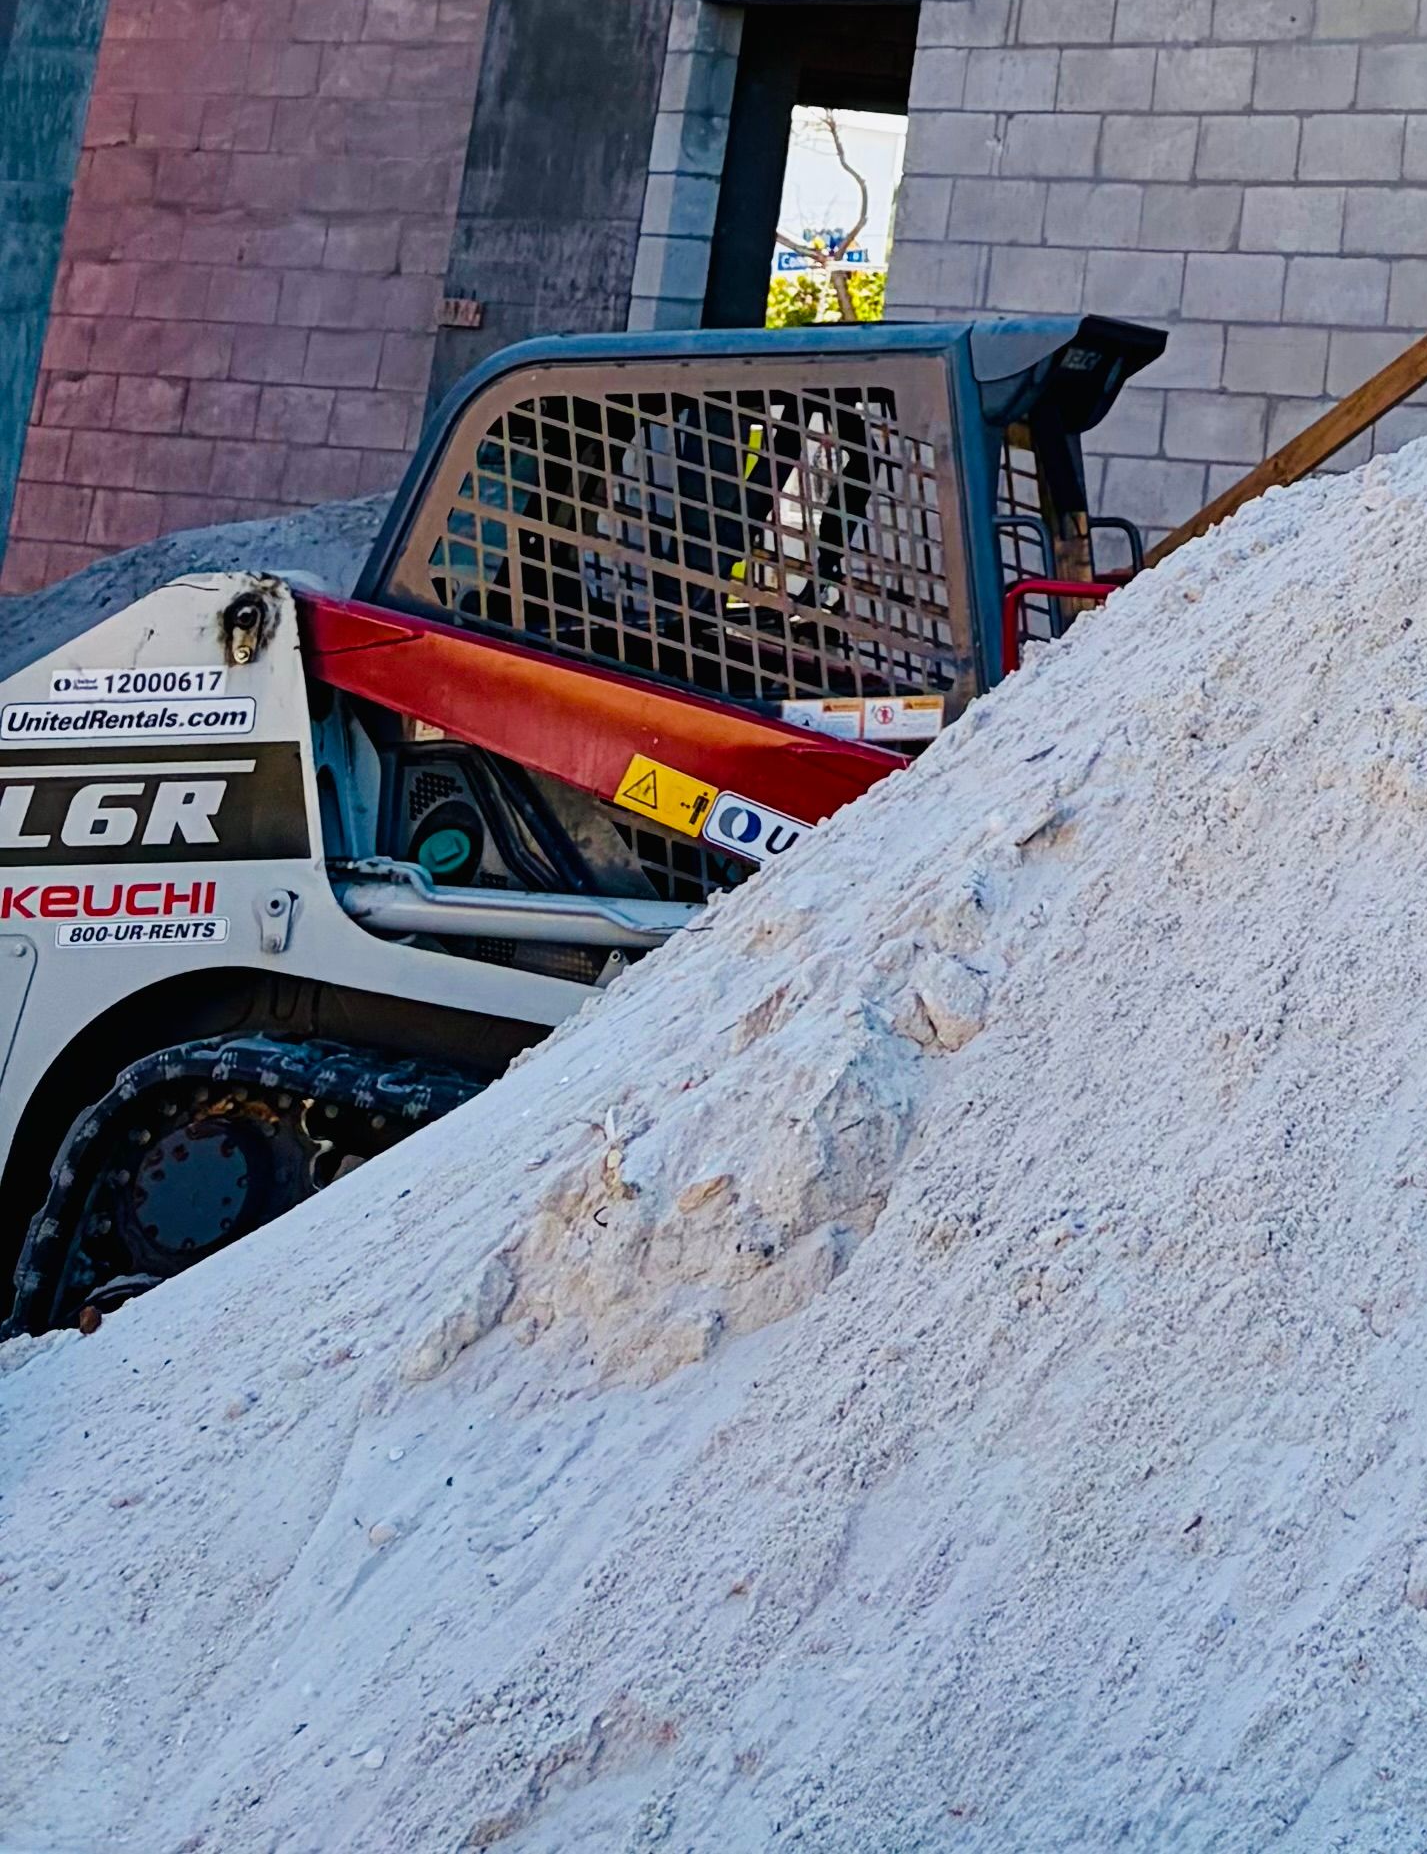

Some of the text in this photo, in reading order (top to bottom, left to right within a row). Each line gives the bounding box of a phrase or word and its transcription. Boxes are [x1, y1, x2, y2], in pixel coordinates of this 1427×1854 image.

[104, 671, 222, 693] 12000617
[7, 708, 248, 732] UnitedRentals.com
[0, 780, 227, 847] L6R
[70, 922, 216, 943] 800-UR-RENTS
